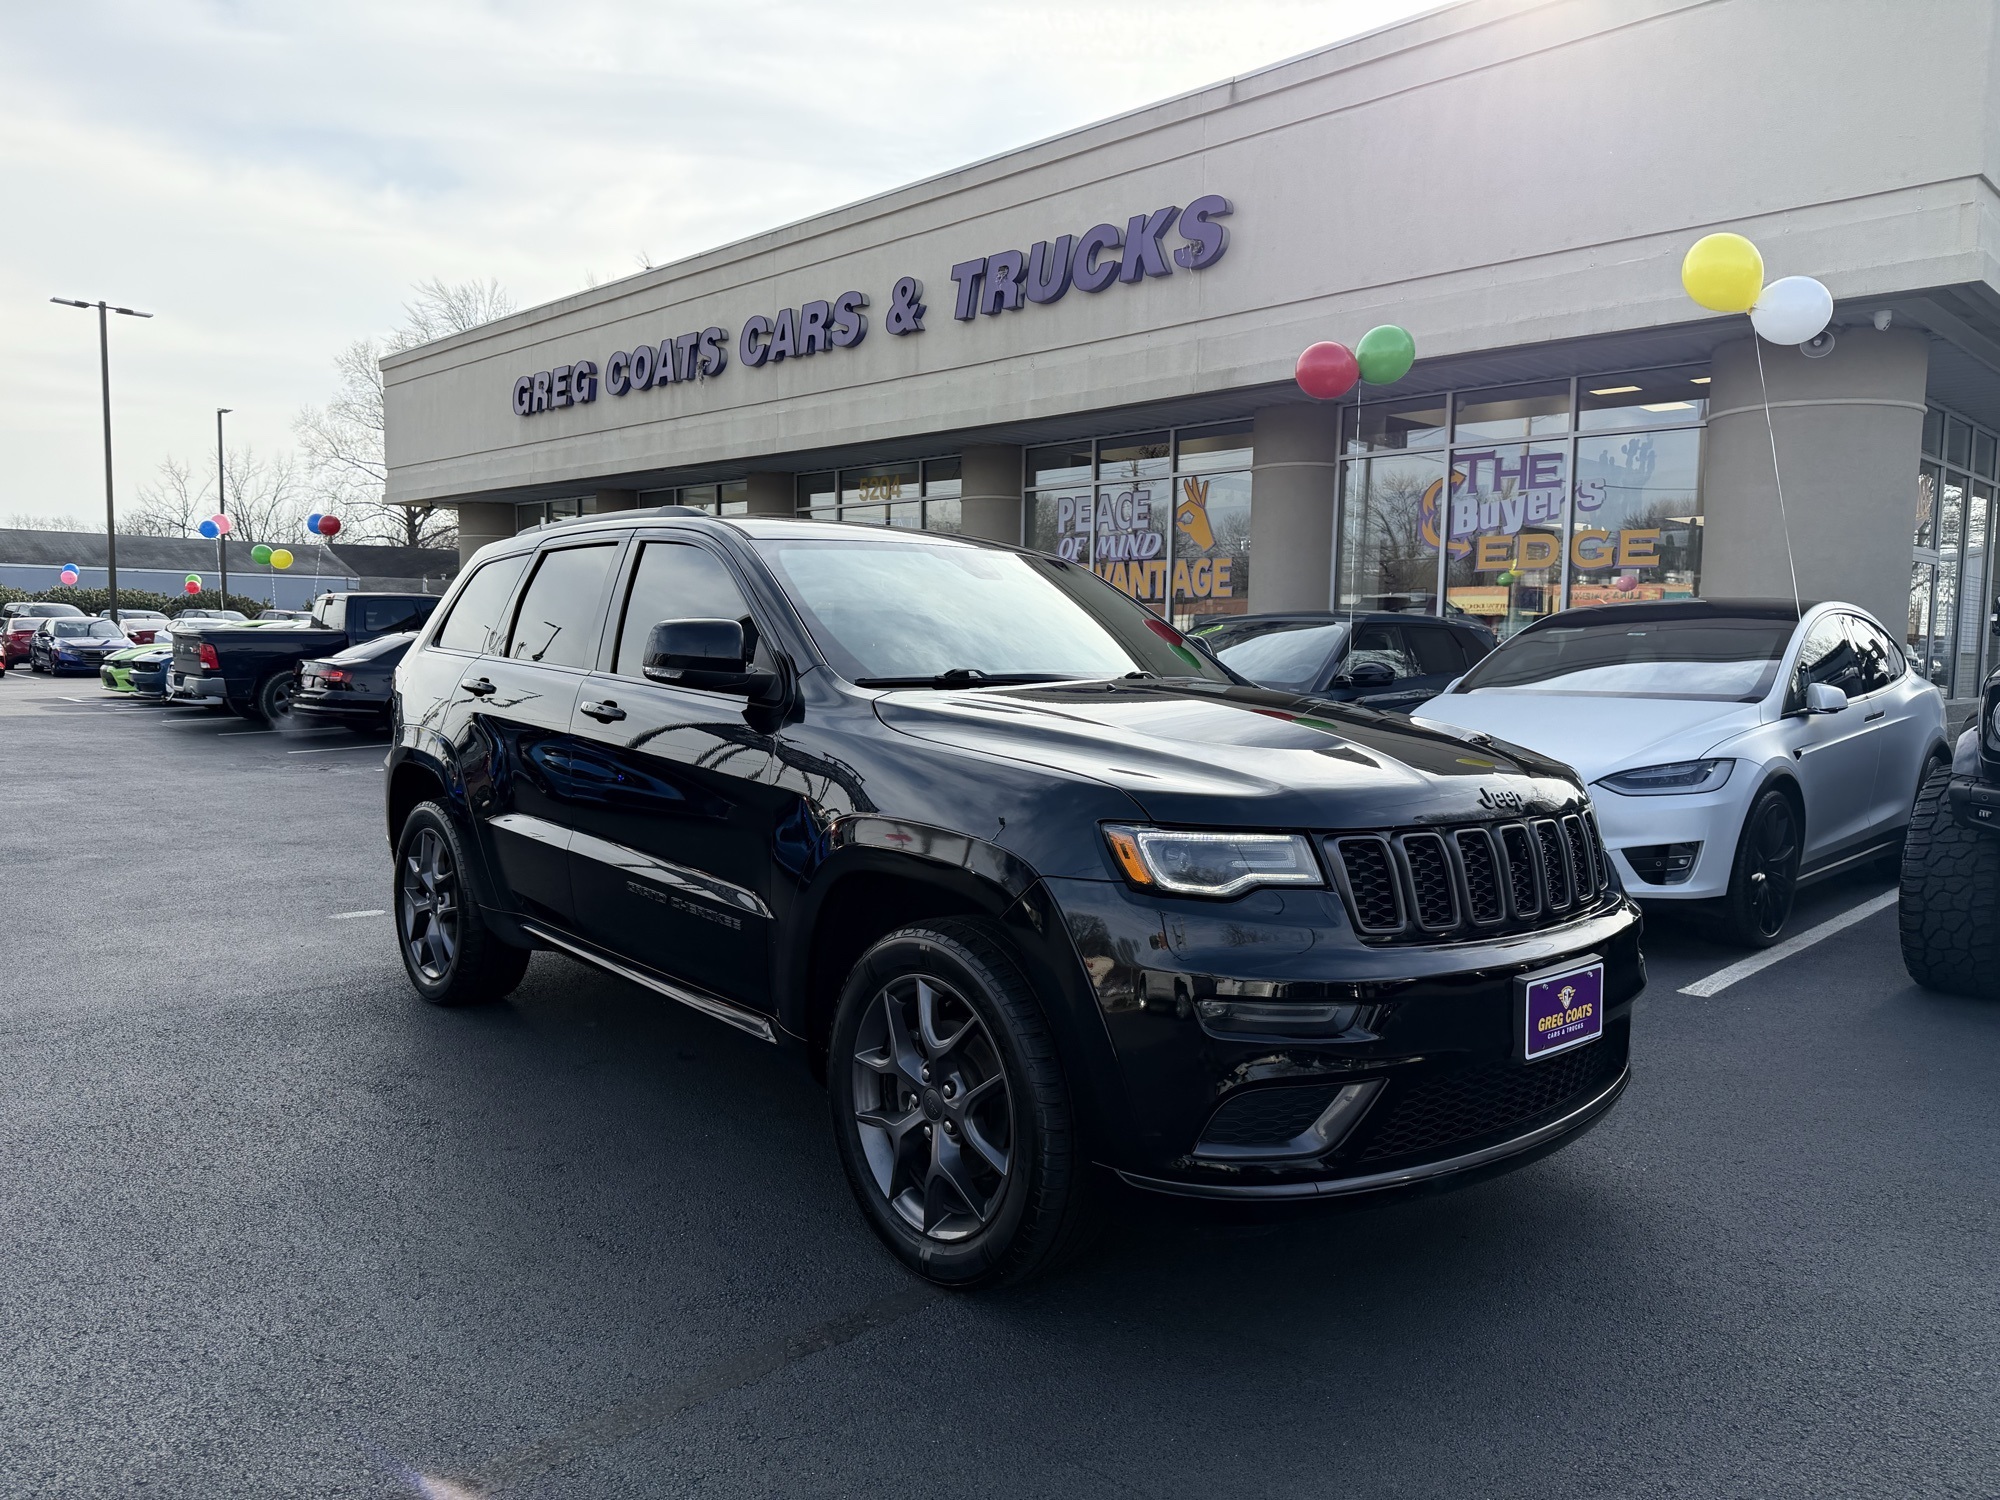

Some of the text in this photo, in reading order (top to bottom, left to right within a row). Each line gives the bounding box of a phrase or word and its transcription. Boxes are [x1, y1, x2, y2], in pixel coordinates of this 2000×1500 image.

[512, 194, 1234, 417] GREG COATS CARS & TRUCKS
[858, 474, 902, 502] 5204
[1452, 449, 1565, 495] THE
[1058, 490, 1151, 534] PEACE
[1057, 532, 1164, 562] OF MIND
[1474, 527, 1661, 573] EDGE
[1080, 557, 1233, 600] VANTAGE
[1477, 787, 1526, 812] Jeep
[1538, 1003, 1592, 1032] GREG COATS
[1547, 1030, 1560, 1040] CARS
